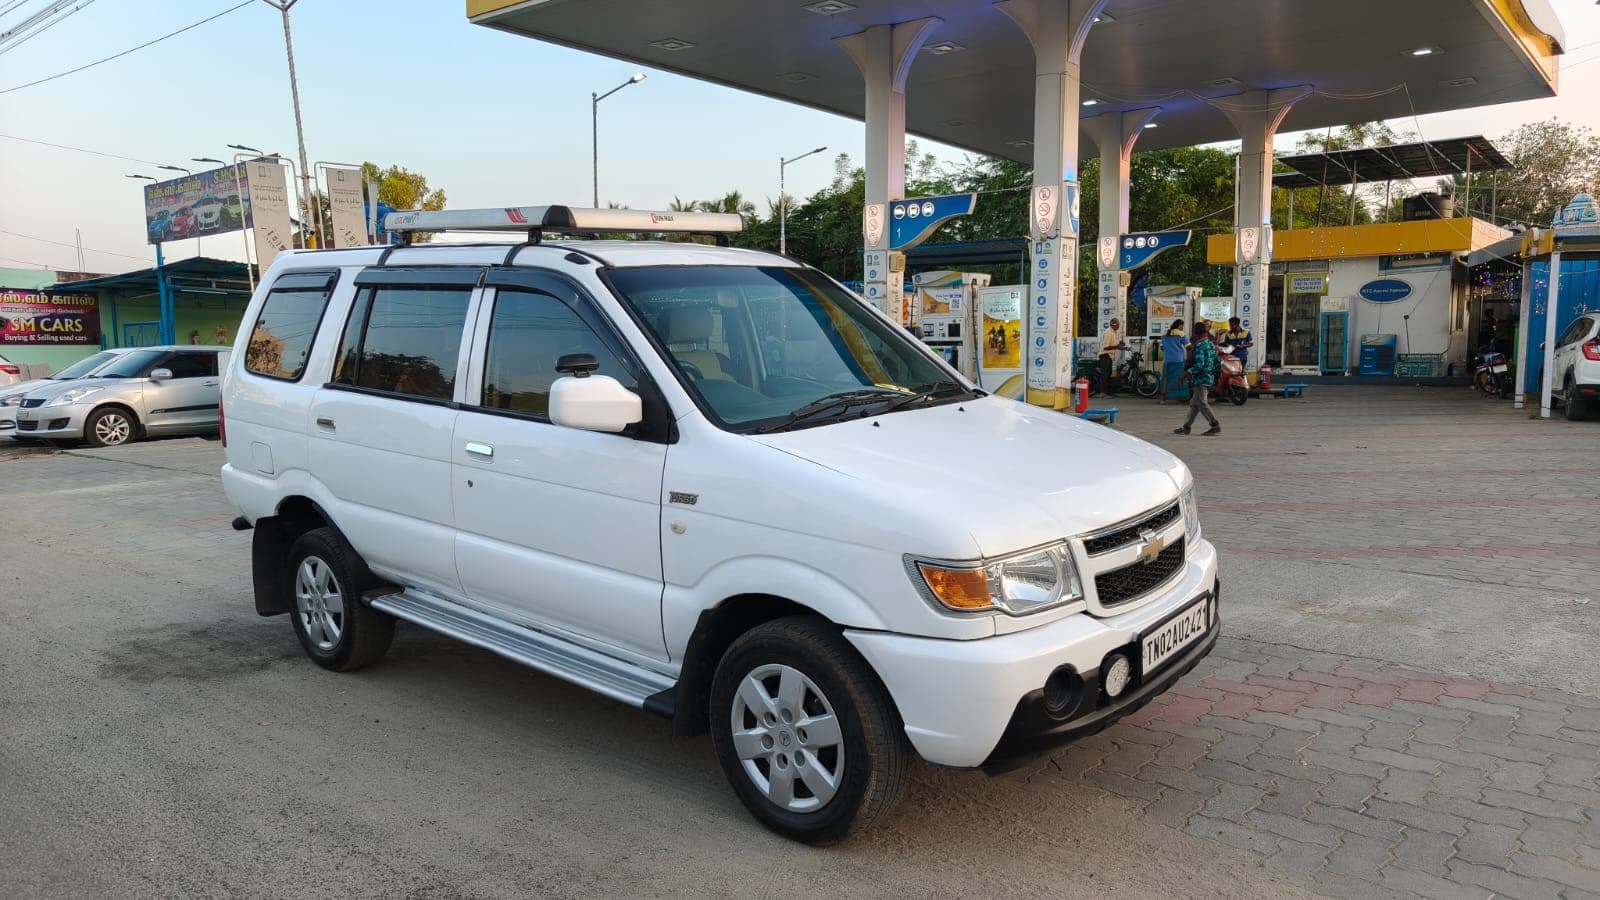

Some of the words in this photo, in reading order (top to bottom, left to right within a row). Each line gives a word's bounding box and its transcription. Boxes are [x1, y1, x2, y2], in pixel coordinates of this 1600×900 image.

[896, 227, 902, 239] 1
[1126, 255, 1132, 264] 3
[11, 318, 36, 332] SM
[40, 318, 83, 332] CARS
[4, 334, 28, 342] Buying
[37, 334, 59, 342] Selling
